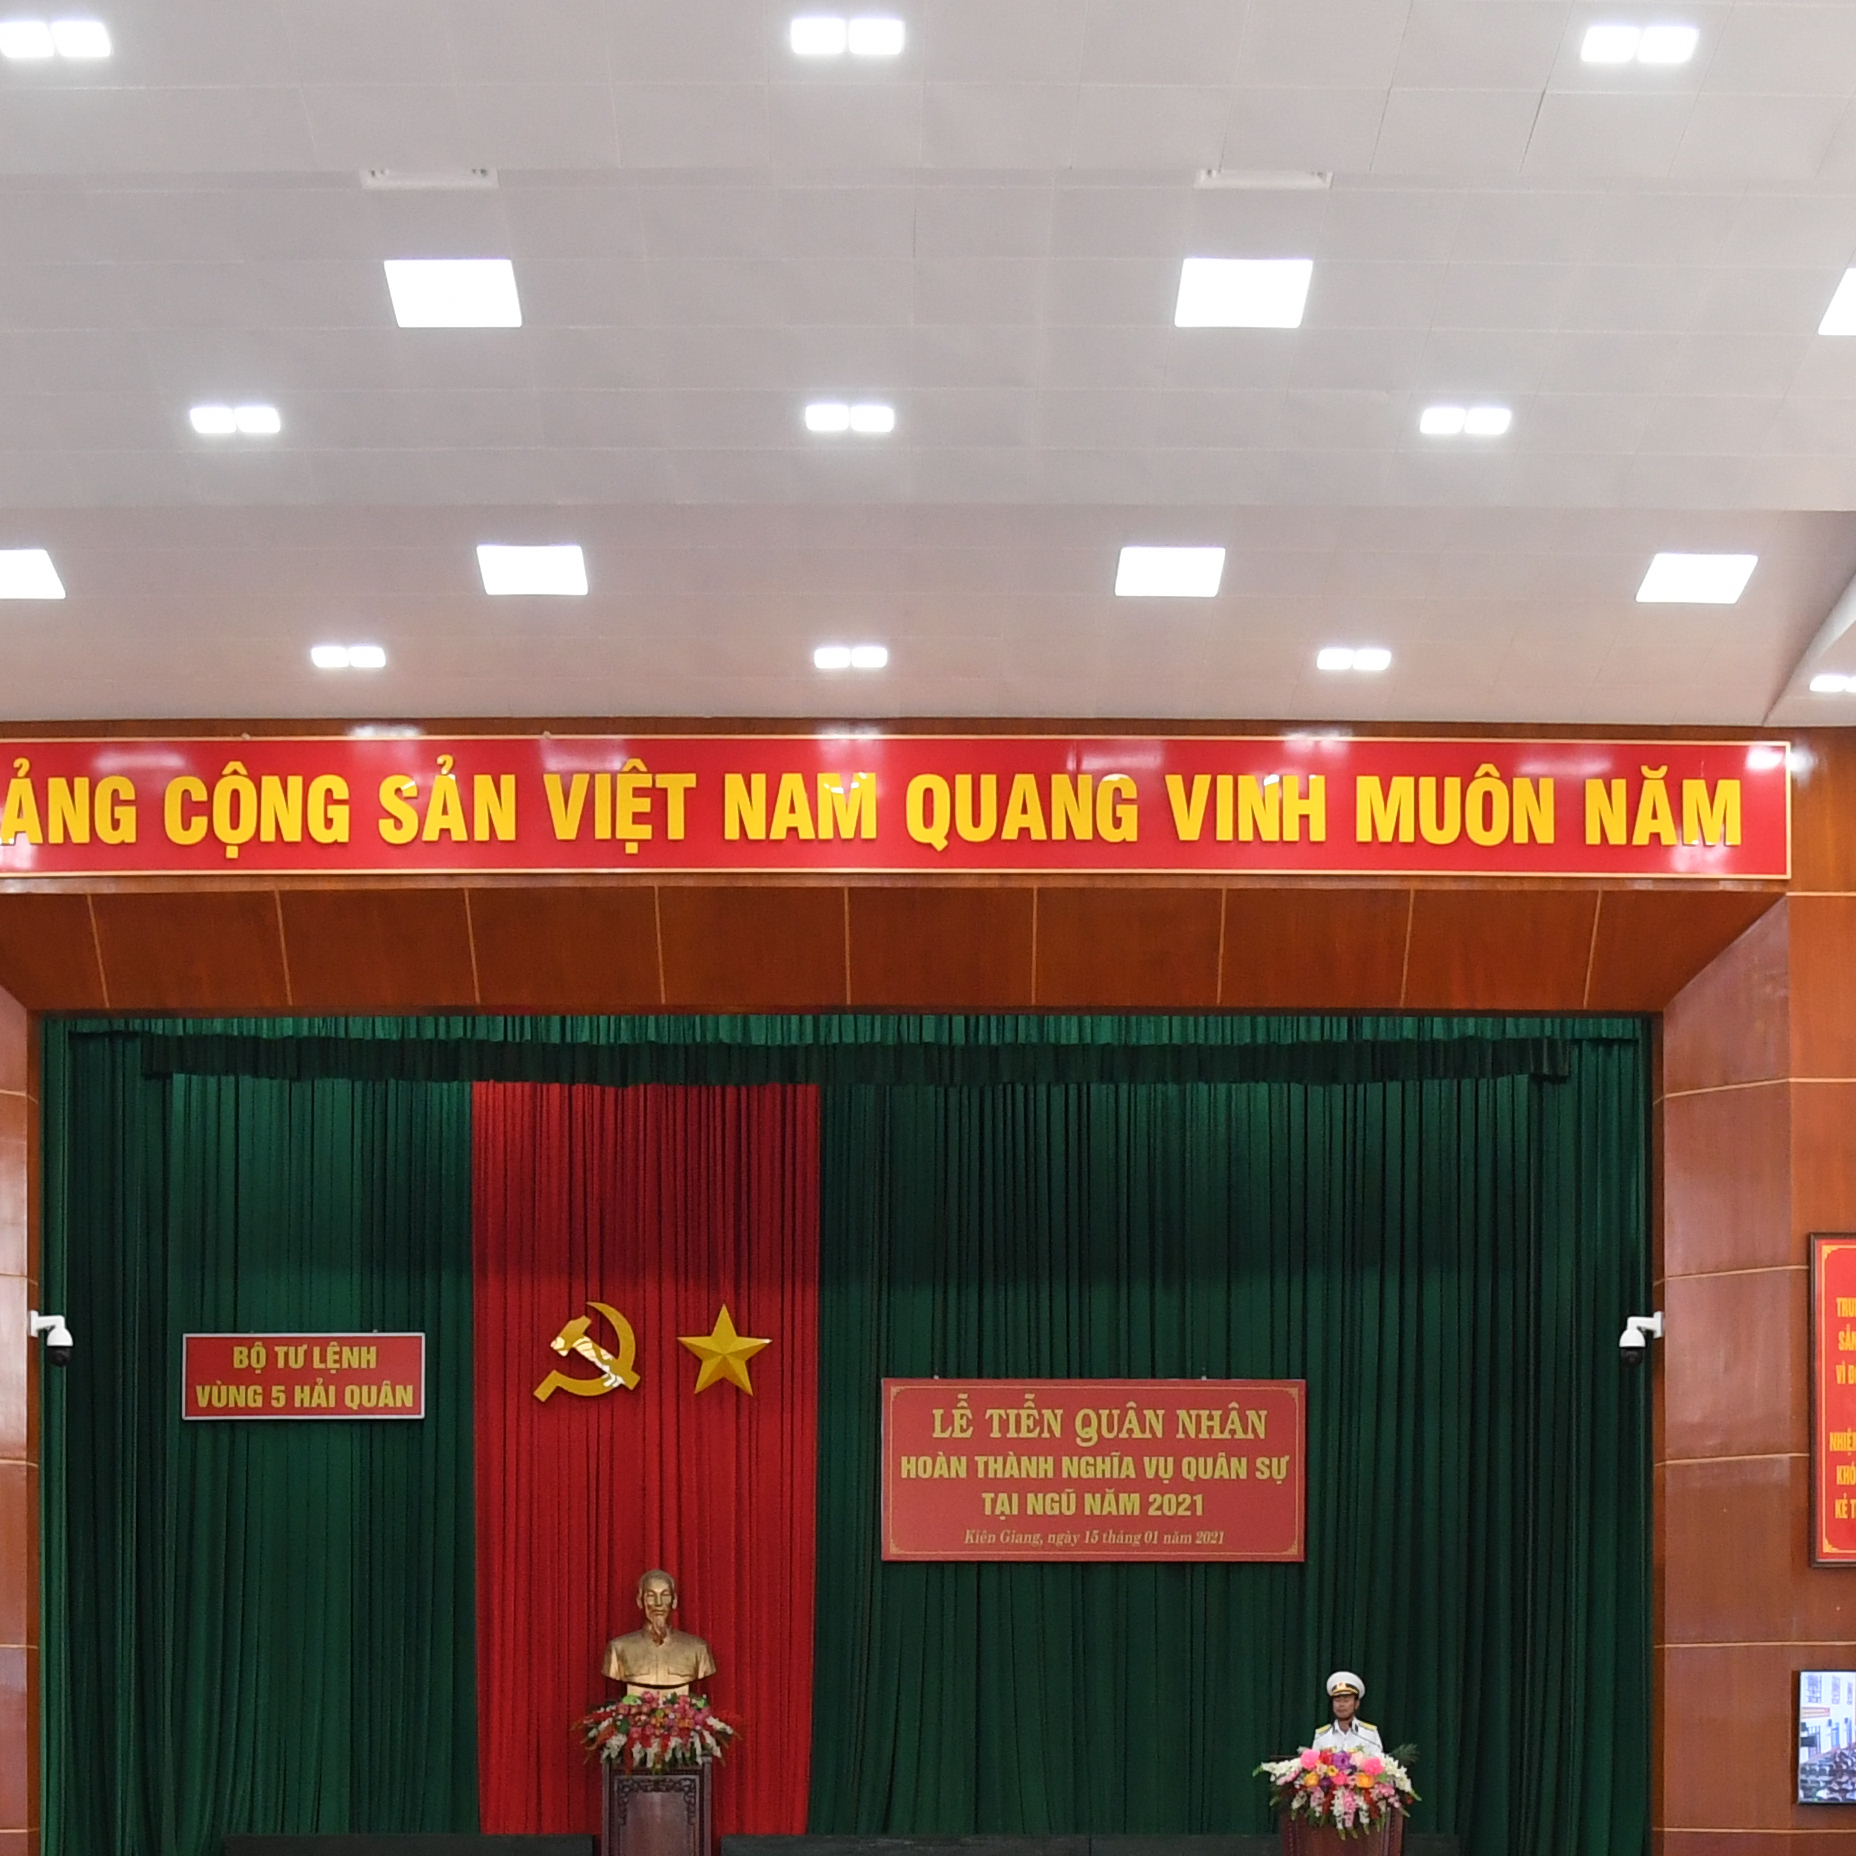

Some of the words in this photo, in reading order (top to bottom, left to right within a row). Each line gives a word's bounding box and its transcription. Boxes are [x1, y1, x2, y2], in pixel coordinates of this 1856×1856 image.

[164, 760, 350, 859] CỘNG
[378, 755, 516, 845] SẢN
[543, 758, 697, 854] VIỆT
[724, 772, 878, 840] NAM
[906, 773, 1138, 852] QUANG
[1165, 773, 1326, 842] VINH
[1356, 764, 1555, 846] MUÔN
[1584, 764, 1742, 847] NĂM
[234, 1342, 266, 1373] BỘ
[275, 1344, 307, 1368] TƯ
[313, 1342, 376, 1373] LỆNH
[196, 1381, 263, 1407] VÙNG
[271, 1386, 286, 1407] 5
[295, 1378, 335, 1407] HẢI
[345, 1380, 413, 1410] QUÂN
[932, 1392, 974, 1439] LỄ
[985, 1392, 1064, 1439] TIỄN
[1075, 1400, 1165, 1447] QUÂN
[1176, 1401, 1268, 1439] NHÂN
[900, 1451, 968, 1479] HOÀN
[974, 1451, 1055, 1479] THÀNH
[1061, 1452, 1136, 1479] NGHĨA
[1143, 1456, 1175, 1484] VỤ
[1181, 1452, 1248, 1482] QUÂN
[1255, 1455, 1290, 1484] SỰ
[981, 1492, 1020, 1520] TẠI
[1026, 1488, 1077, 1515] NGŨ
[1084, 1488, 1141, 1516] NĂM
[1148, 1493, 1203, 1516] 2021
[964, 1529, 996, 1544] Kiên
[999, 1529, 1044, 1547] Giang,
[1047, 1530, 1081, 1547] ngày
[1102, 1529, 1143, 1547] tháng
[1163, 1531, 1193, 1545] năm
[1195, 1530, 1225, 1545] 2021
